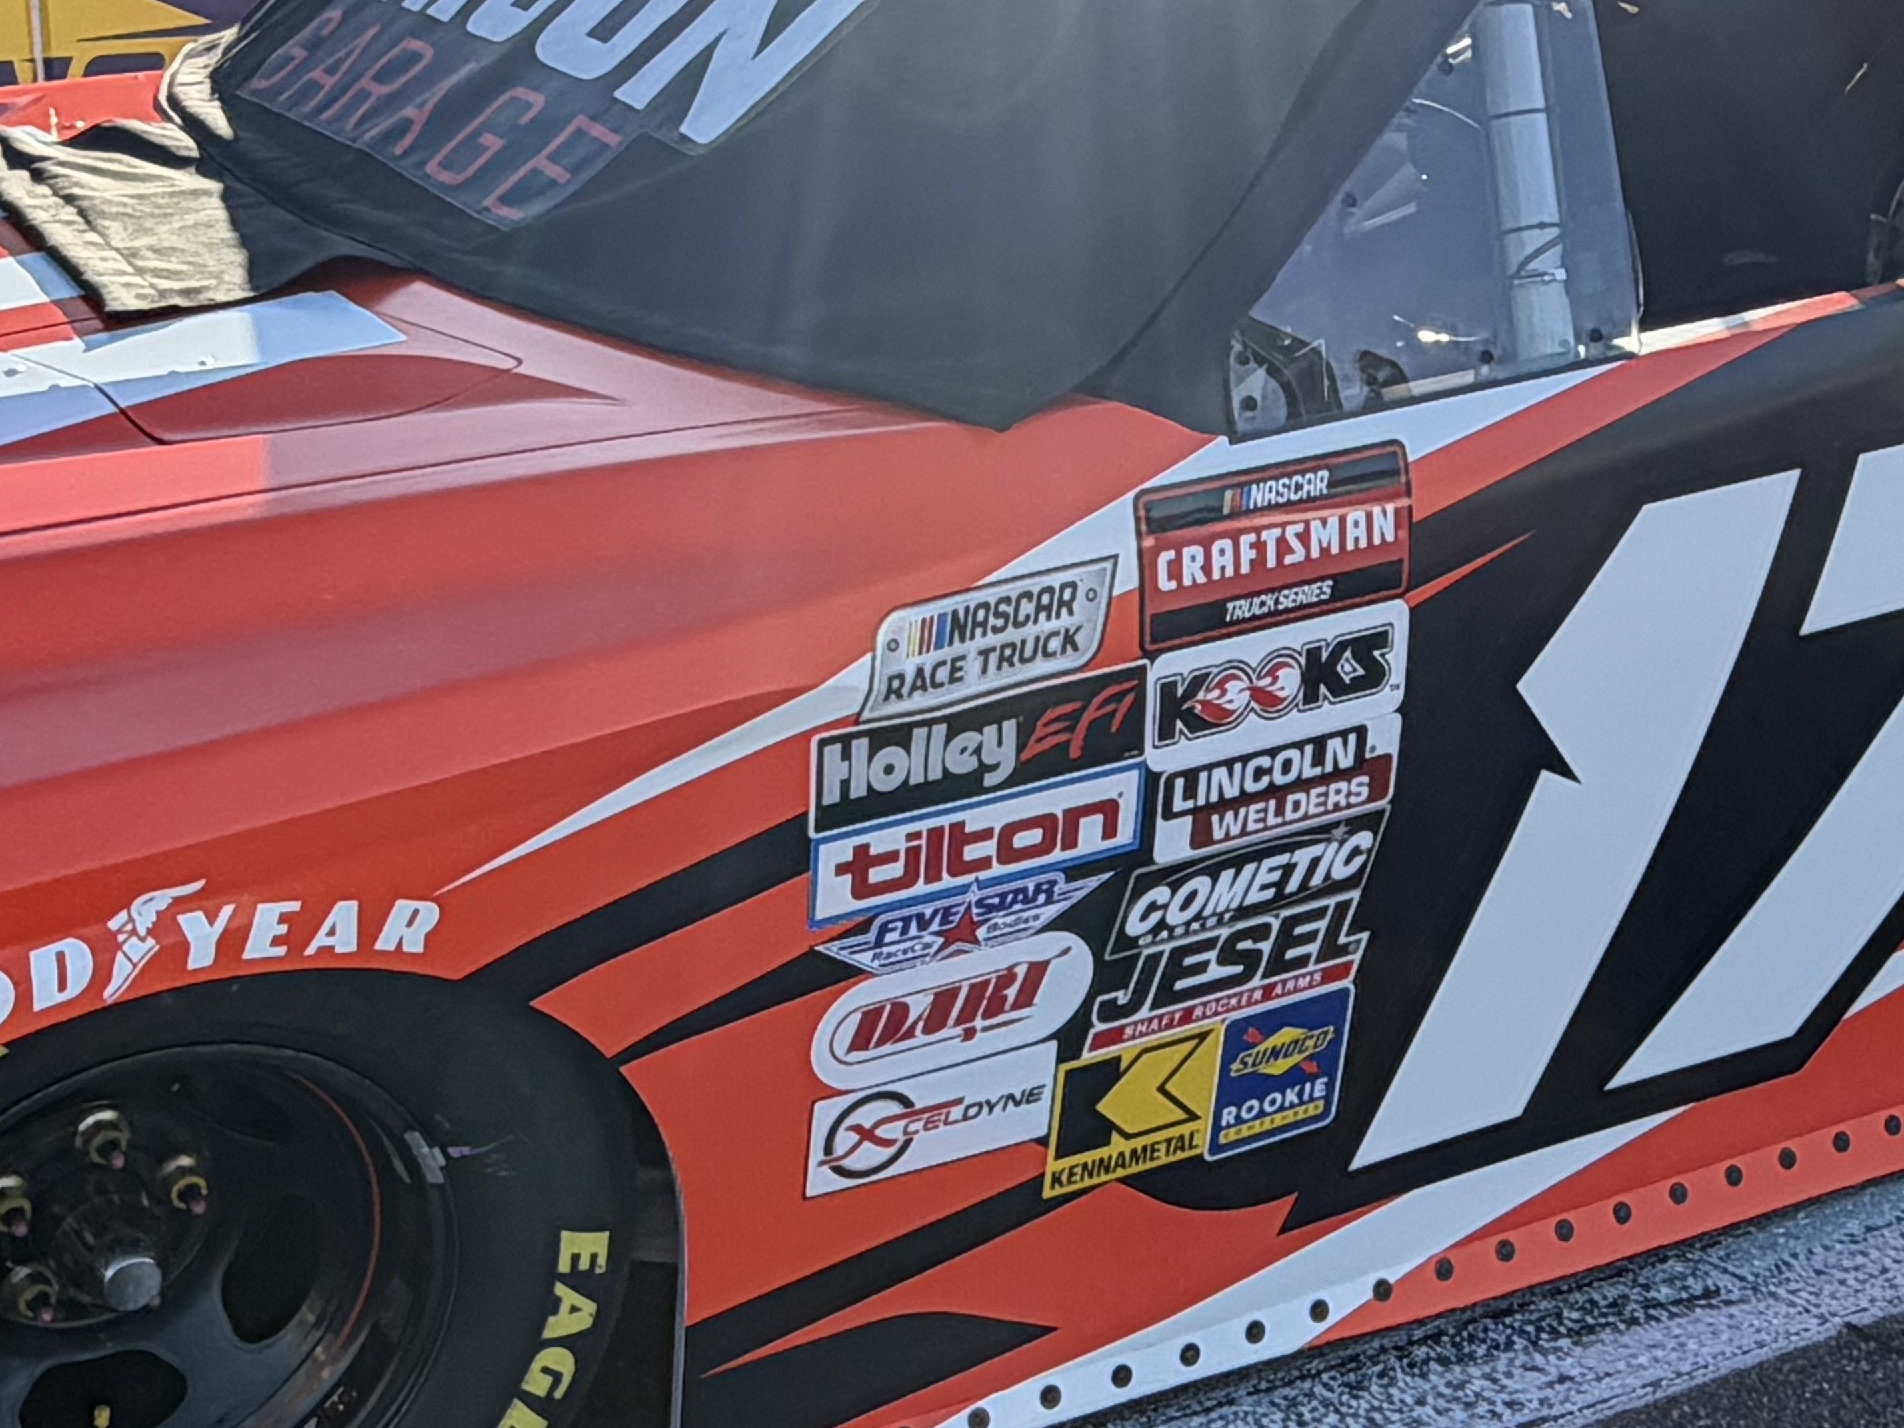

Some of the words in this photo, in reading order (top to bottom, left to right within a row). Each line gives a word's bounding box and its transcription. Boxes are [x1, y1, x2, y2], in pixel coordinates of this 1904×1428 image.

[250, 8, 623, 221] GARAGE
[1249, 469, 1329, 511] NASCAR
[1157, 504, 1396, 592] CRAFTSMAN
[946, 578, 1078, 644] NASCAR
[1225, 589, 1279, 622] TRUCK
[1276, 578, 1333, 611] SERIES
[883, 650, 964, 703] RACE
[980, 623, 1082, 676] TRUCK
[1154, 624, 1394, 749] KOOKS
[822, 715, 1019, 808] Holley
[1172, 729, 1358, 811] LINCOLN
[1211, 775, 1370, 841] WELDERS
[836, 797, 1120, 901] tilton
[1124, 830, 1375, 938] COMETIC
[874, 903, 960, 948] FIVE
[974, 881, 1058, 918] STAR
[1095, 896, 1363, 1023] JESEL
[846, 946, 1074, 1055] DART
[1122, 1013, 1182, 1040] SHAFT
[1192, 986, 1264, 1020] ROCKER
[1272, 971, 1323, 998] ARMS
[1236, 1030, 1330, 1073] SUNOCO
[1220, 1077, 1329, 1127] ROOKIE
[1049, 1128, 1200, 1191] KENNAMETAL
